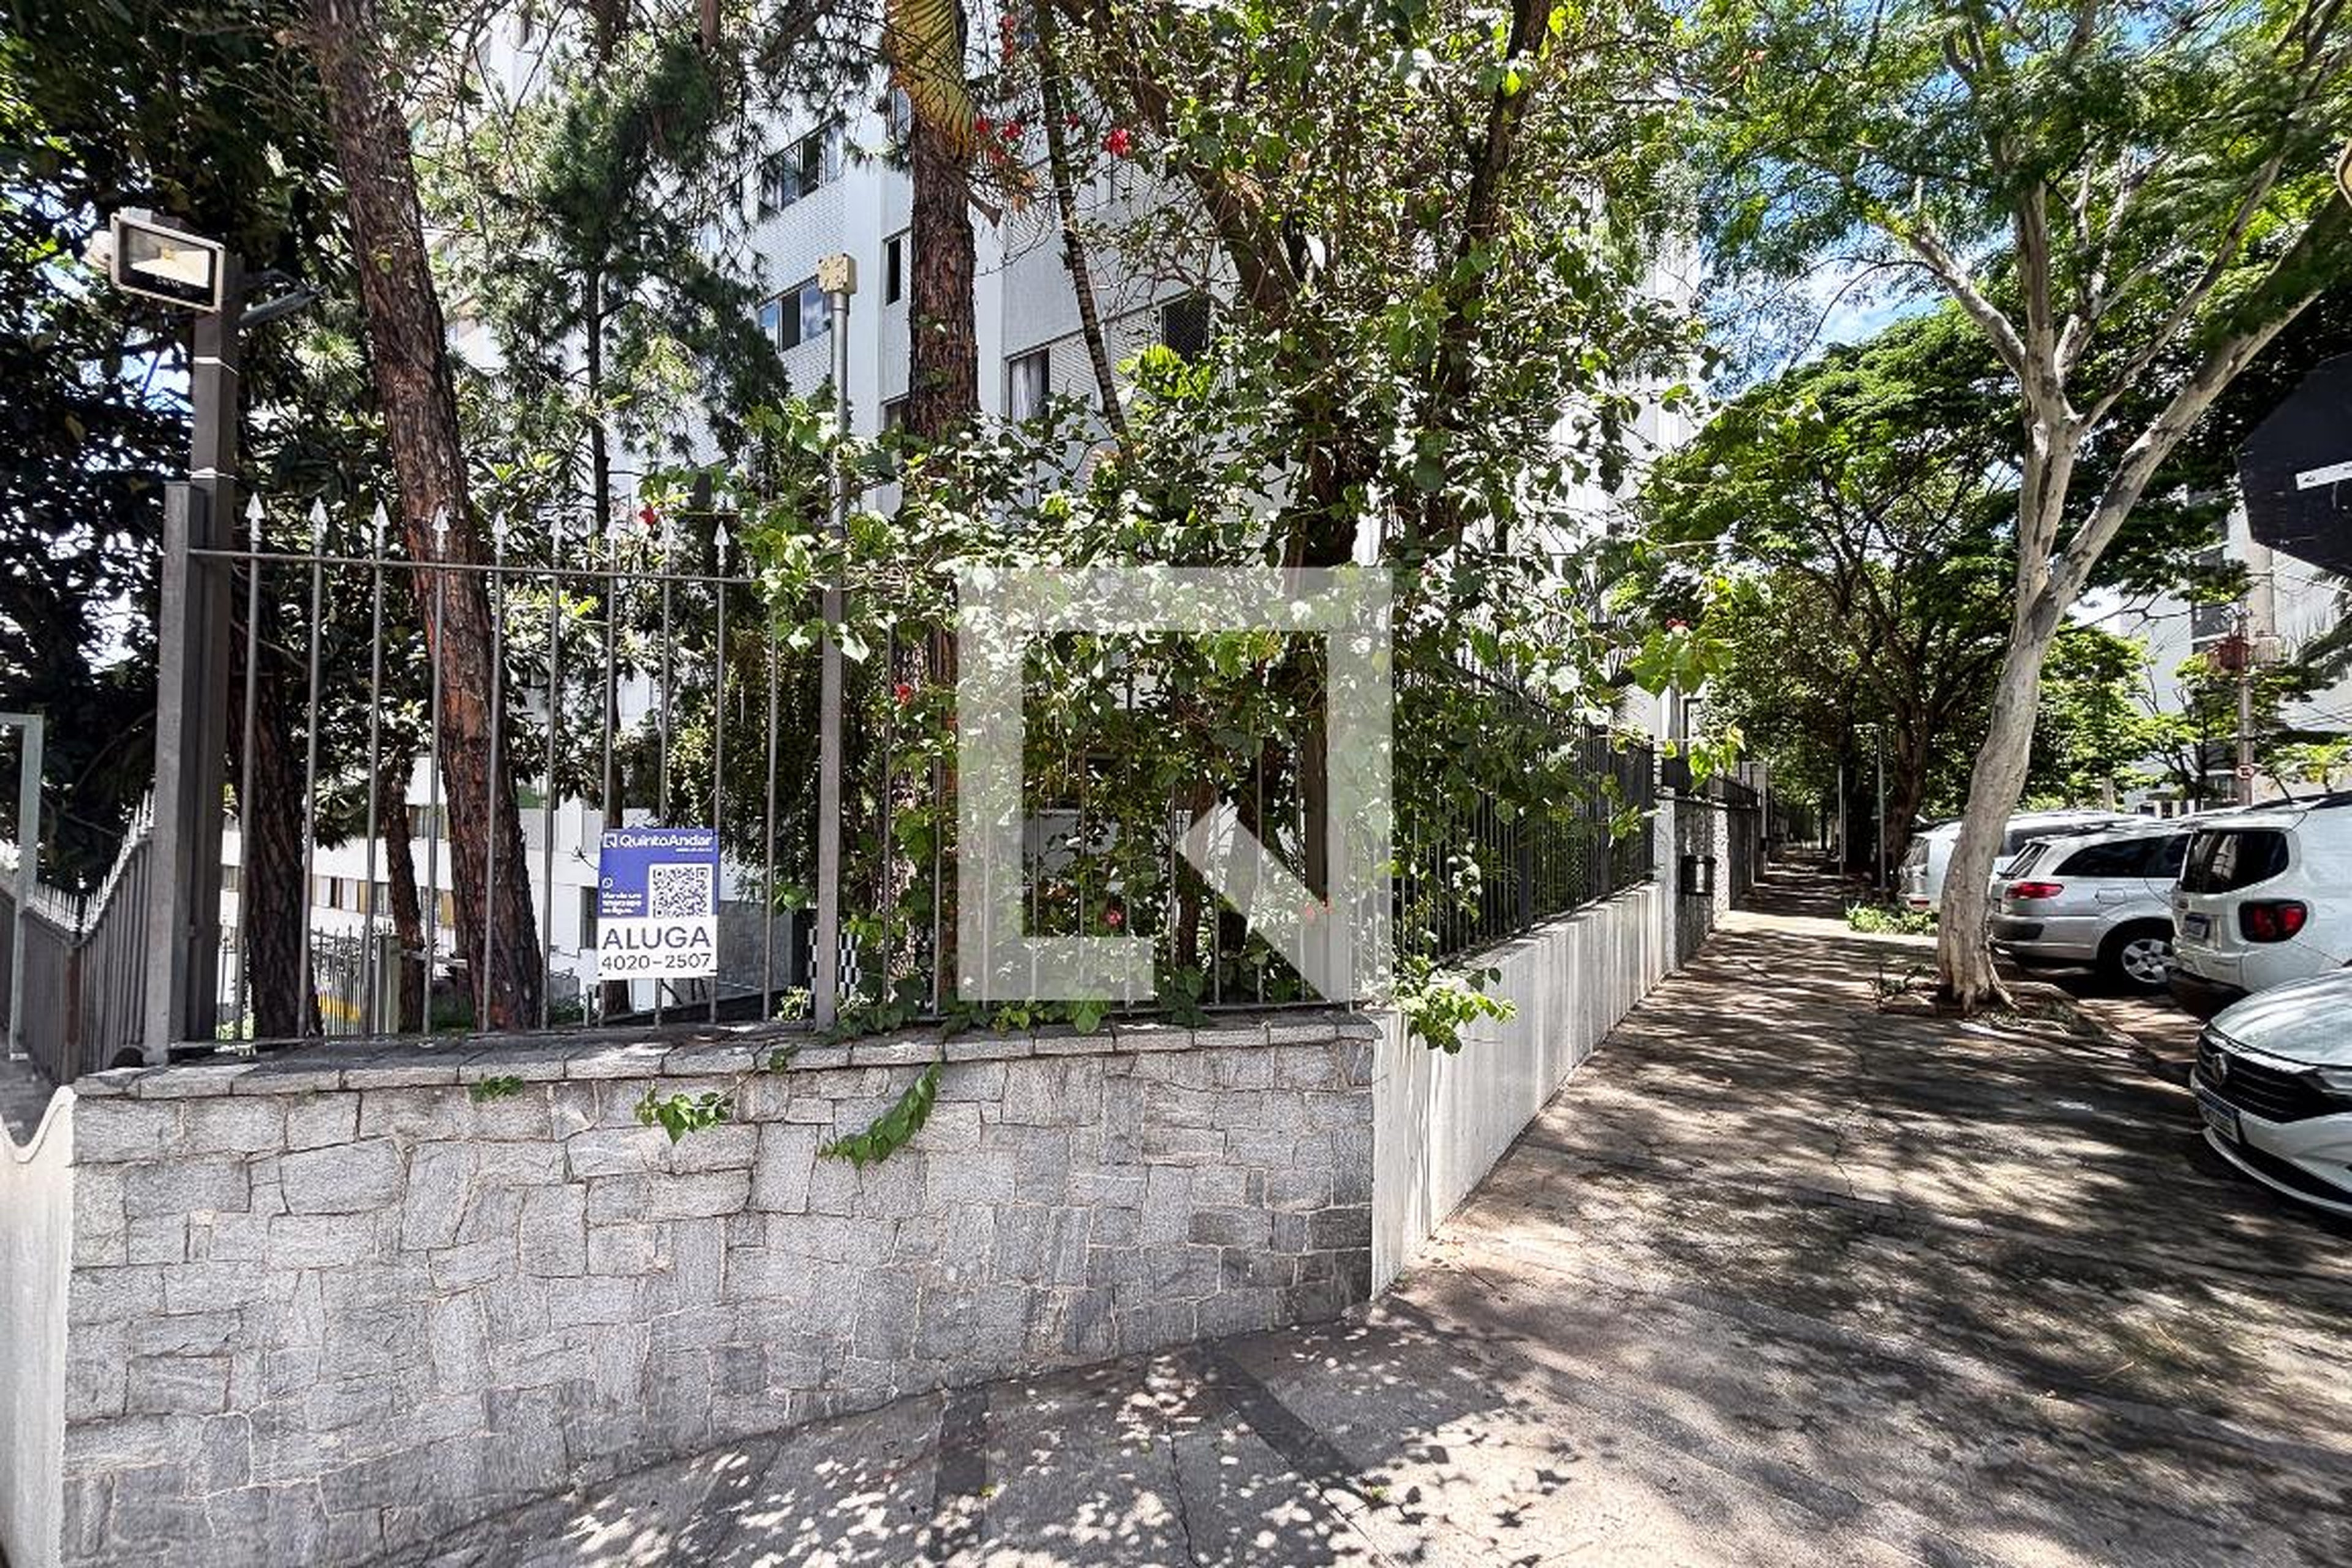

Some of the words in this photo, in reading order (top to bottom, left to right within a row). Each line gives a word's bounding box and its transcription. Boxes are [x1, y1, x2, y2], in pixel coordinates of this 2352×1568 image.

[620, 834, 713, 847] QuintoAndar
[602, 926, 711, 949] ALUGA
[602, 953, 711, 970] 4020-2507
